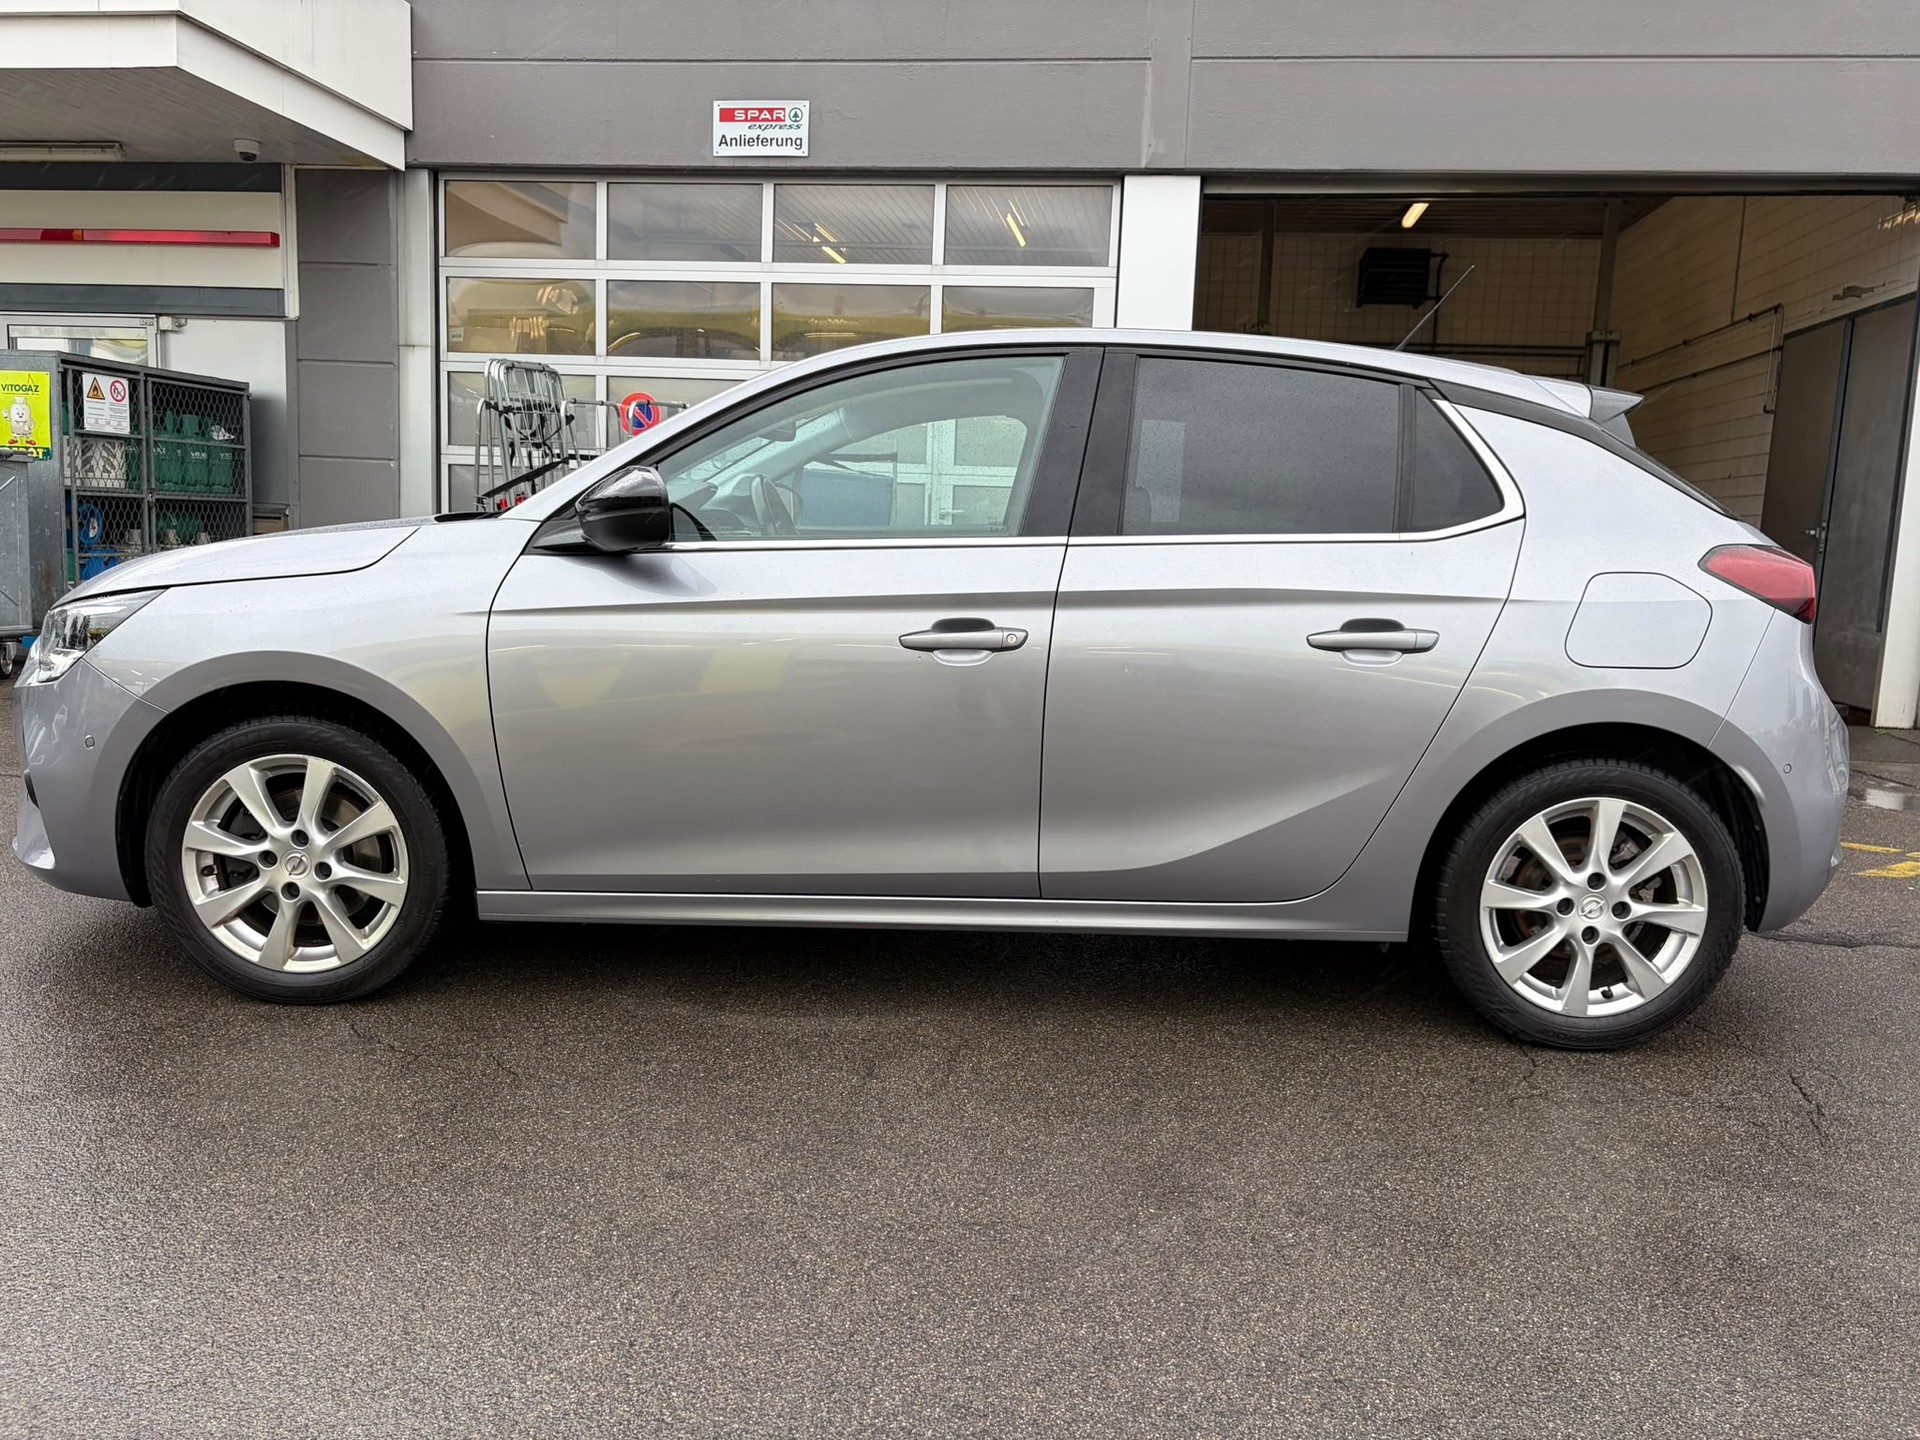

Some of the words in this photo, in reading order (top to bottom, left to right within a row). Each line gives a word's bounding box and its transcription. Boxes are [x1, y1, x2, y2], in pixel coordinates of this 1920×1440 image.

[734, 110, 785, 120] SPAR
[748, 123, 803, 132] express
[718, 134, 803, 151] Anlieferung
